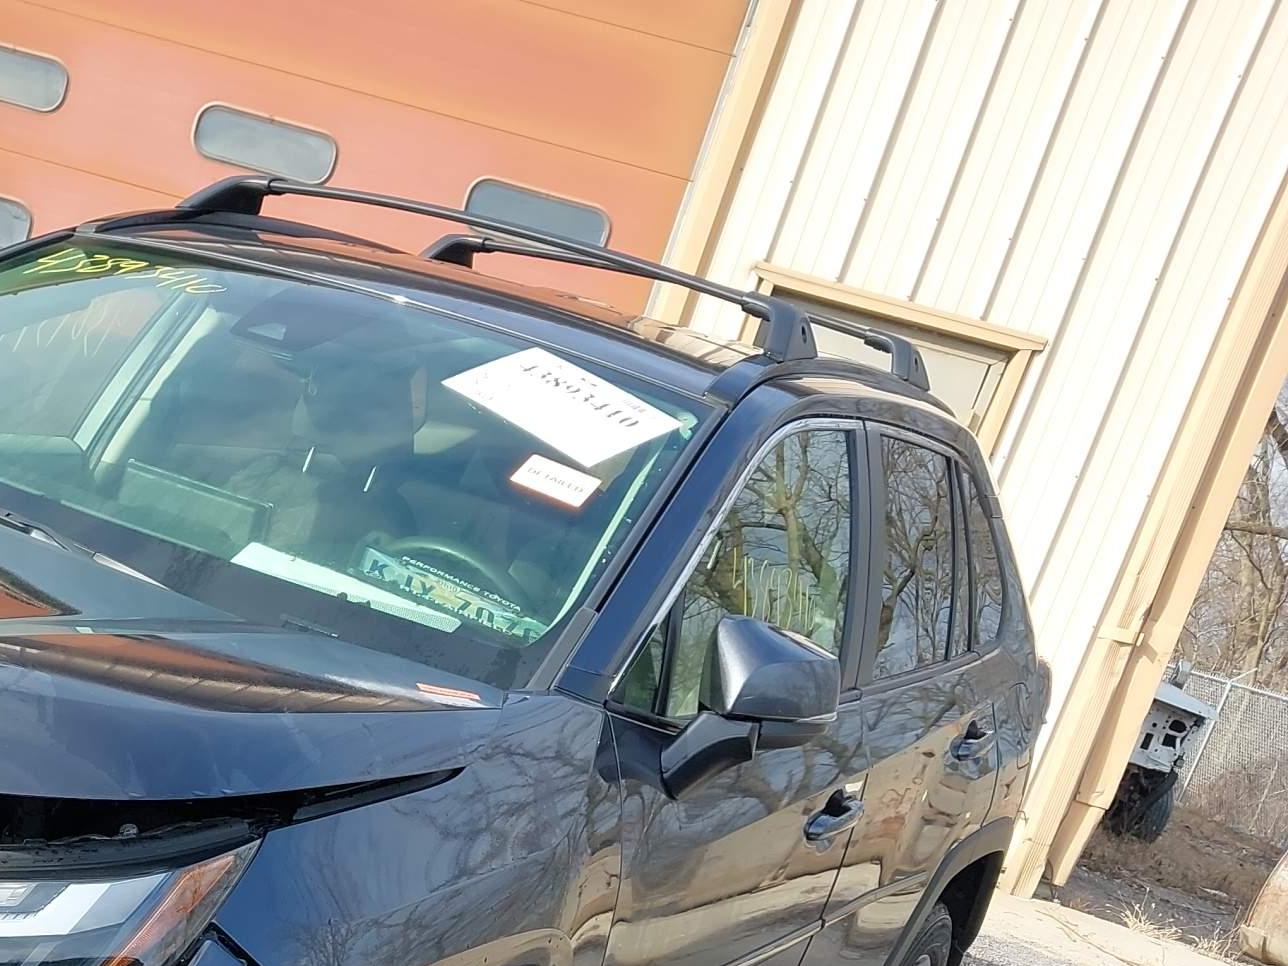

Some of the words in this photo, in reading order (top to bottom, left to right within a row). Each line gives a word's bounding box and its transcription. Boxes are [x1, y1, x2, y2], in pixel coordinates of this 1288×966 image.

[520, 364, 640, 428] 43893410
[402, 555, 481, 593] PERFORMANCE
[483, 589, 521, 613] TOYOTA
